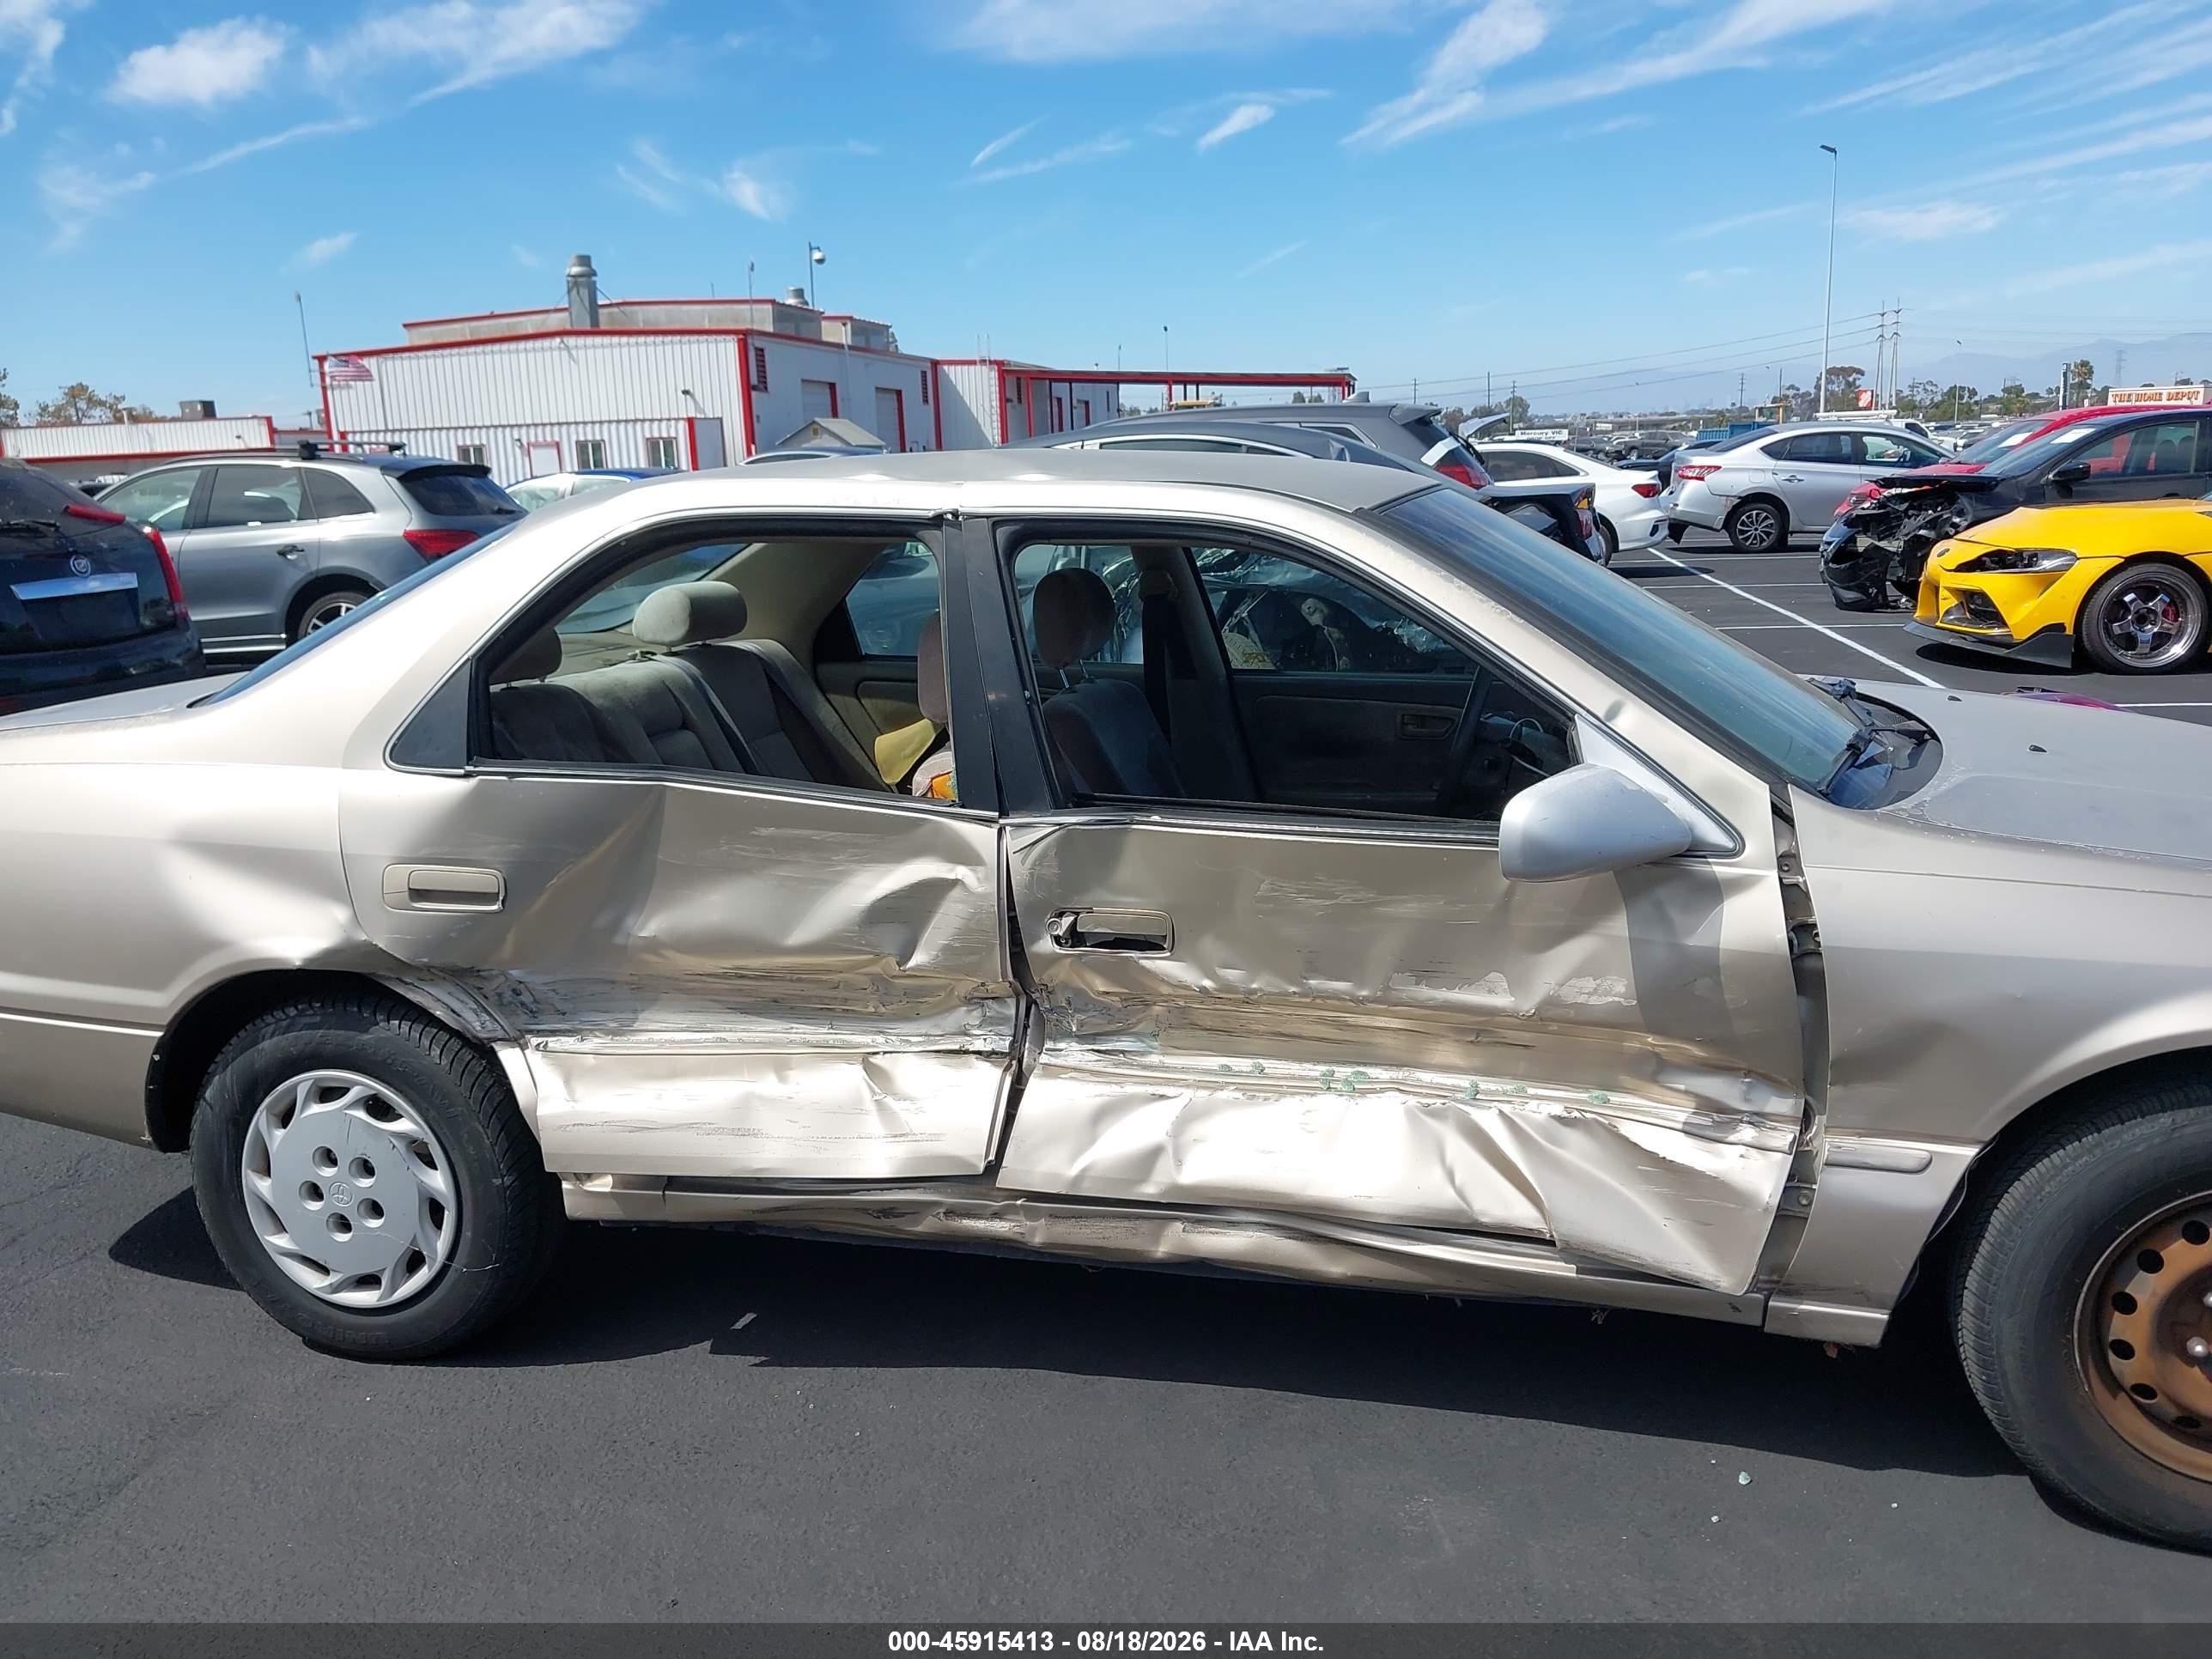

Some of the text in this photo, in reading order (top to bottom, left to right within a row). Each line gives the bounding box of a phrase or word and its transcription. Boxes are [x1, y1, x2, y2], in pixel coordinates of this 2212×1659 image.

[2112, 391, 2200, 403] THE HOME DEPOT
